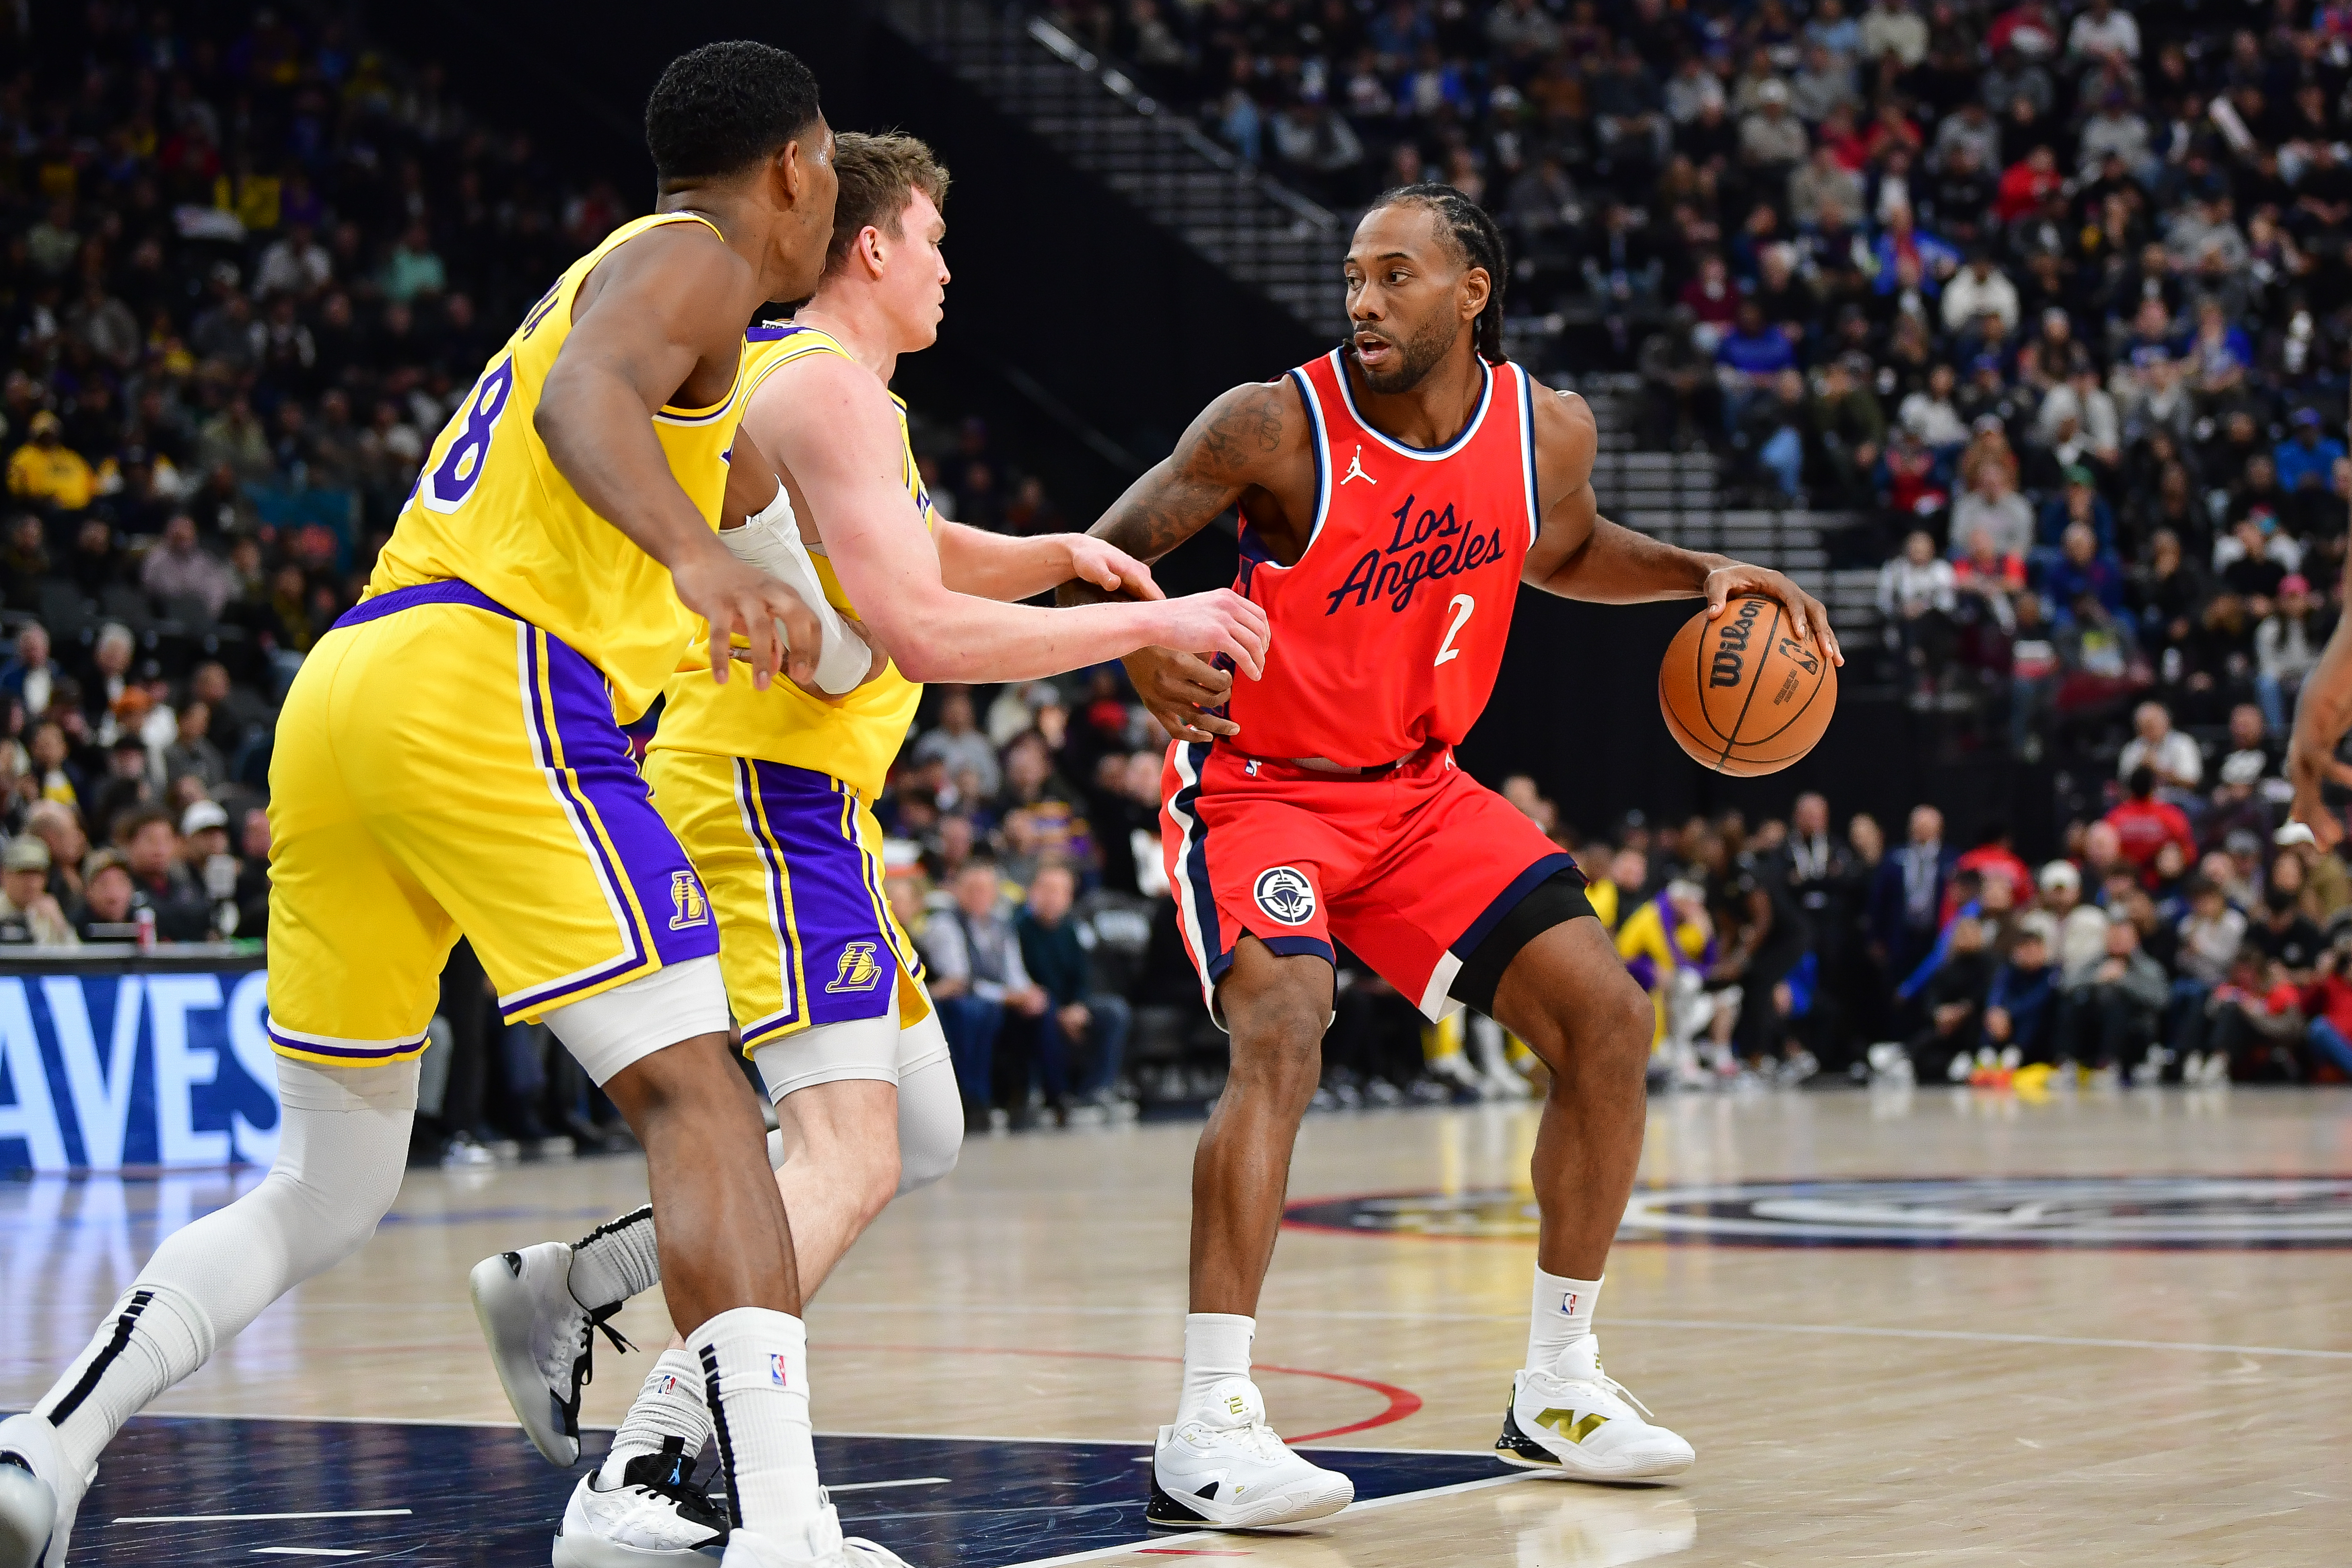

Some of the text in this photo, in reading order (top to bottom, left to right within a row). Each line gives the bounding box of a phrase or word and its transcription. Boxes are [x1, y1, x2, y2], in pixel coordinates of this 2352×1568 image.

[399, 350, 513, 515] 8
[1325, 519, 1506, 617] Angeles
[1385, 493, 1462, 555] Los
[1434, 593, 1475, 667] 2
[1708, 600, 1767, 689] Wilson
